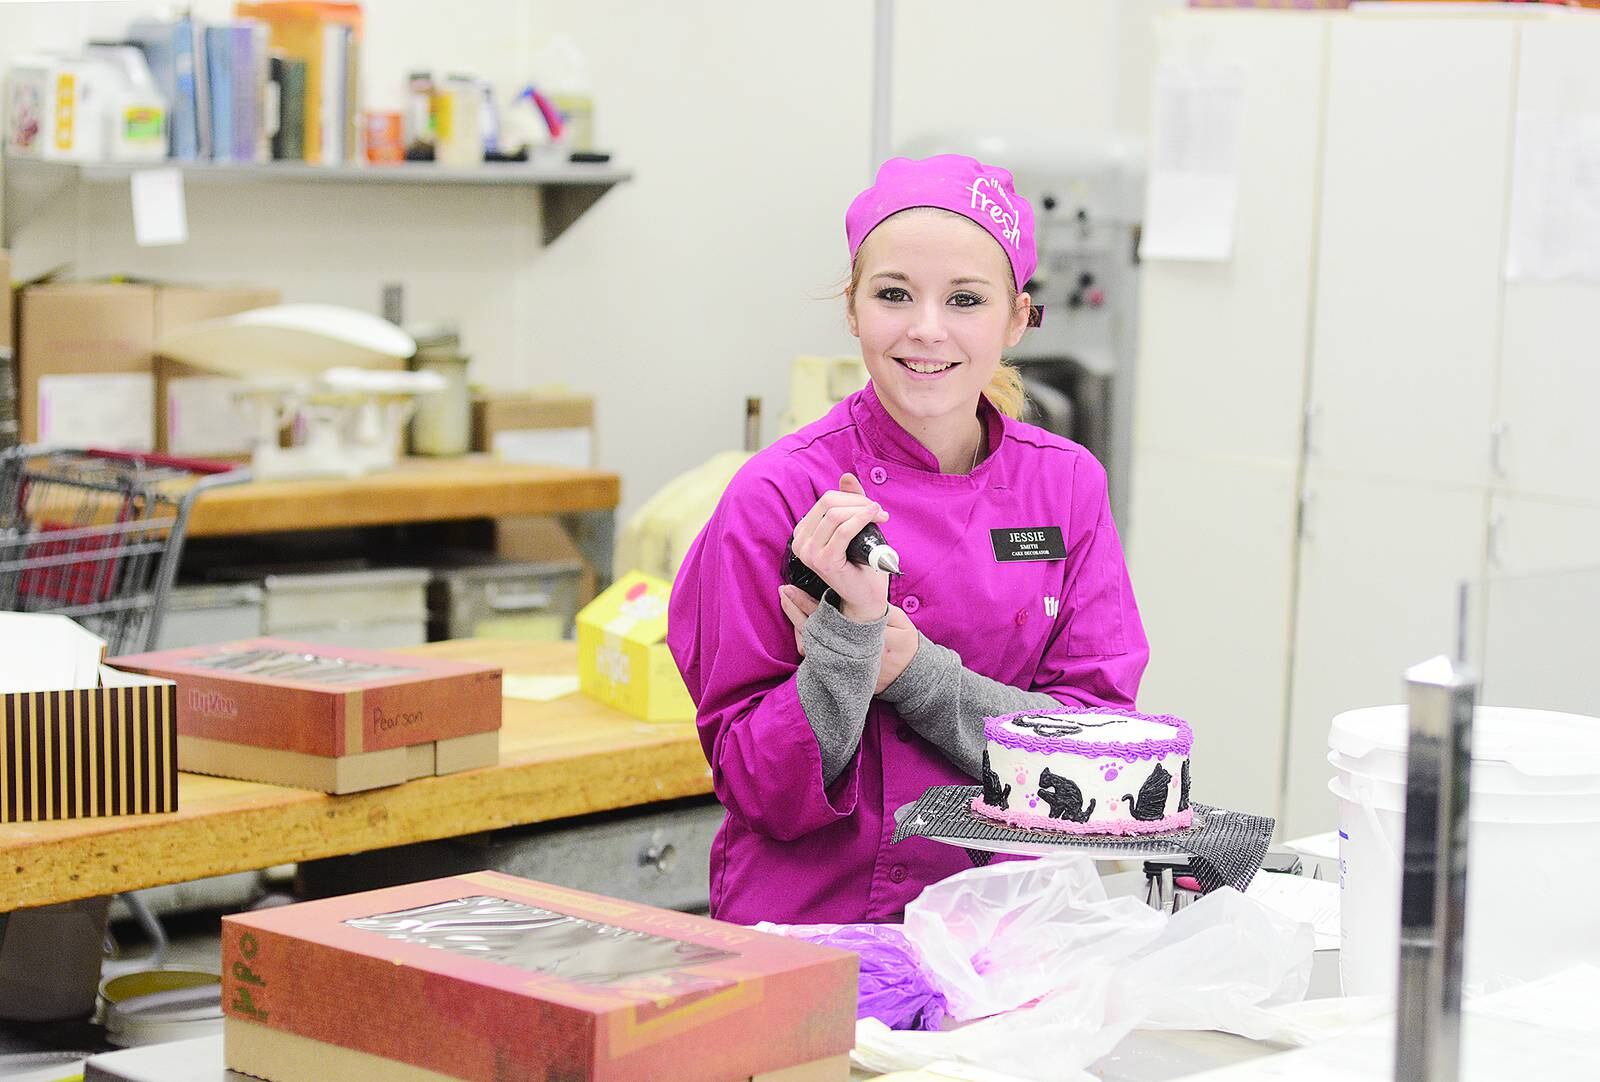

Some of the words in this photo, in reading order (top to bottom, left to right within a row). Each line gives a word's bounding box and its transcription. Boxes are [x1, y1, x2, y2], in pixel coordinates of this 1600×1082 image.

[965, 177, 1021, 250] fresh
[1009, 531, 1046, 543] JESSIE
[372, 706, 423, 736] Pearson
